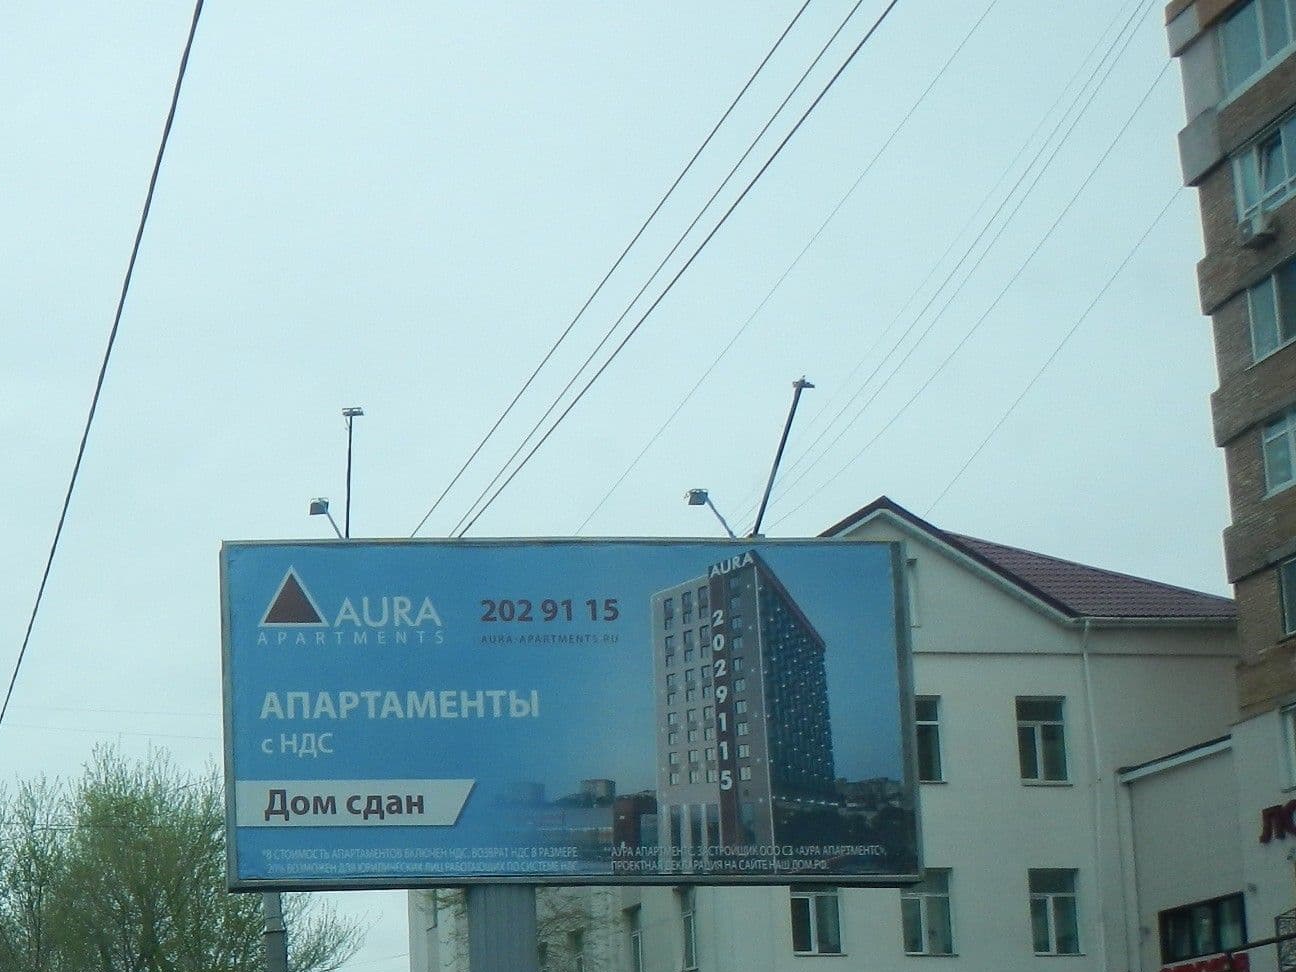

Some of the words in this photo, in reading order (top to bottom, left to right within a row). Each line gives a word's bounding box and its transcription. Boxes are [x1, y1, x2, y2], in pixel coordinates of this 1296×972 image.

[710, 552, 753, 579] AURA
[334, 596, 443, 628] AURA
[480, 598, 533, 622] 202
[541, 598, 573, 622] 91
[586, 598, 620, 622] 15
[257, 630, 444, 646] APARTMENTS
[259, 689, 540, 719] АПАРТАМЕНТЫ
[261, 737, 273, 754] с
[280, 732, 334, 758] НДС
[264, 789, 337, 821] Дом
[346, 794, 425, 820] сдан
